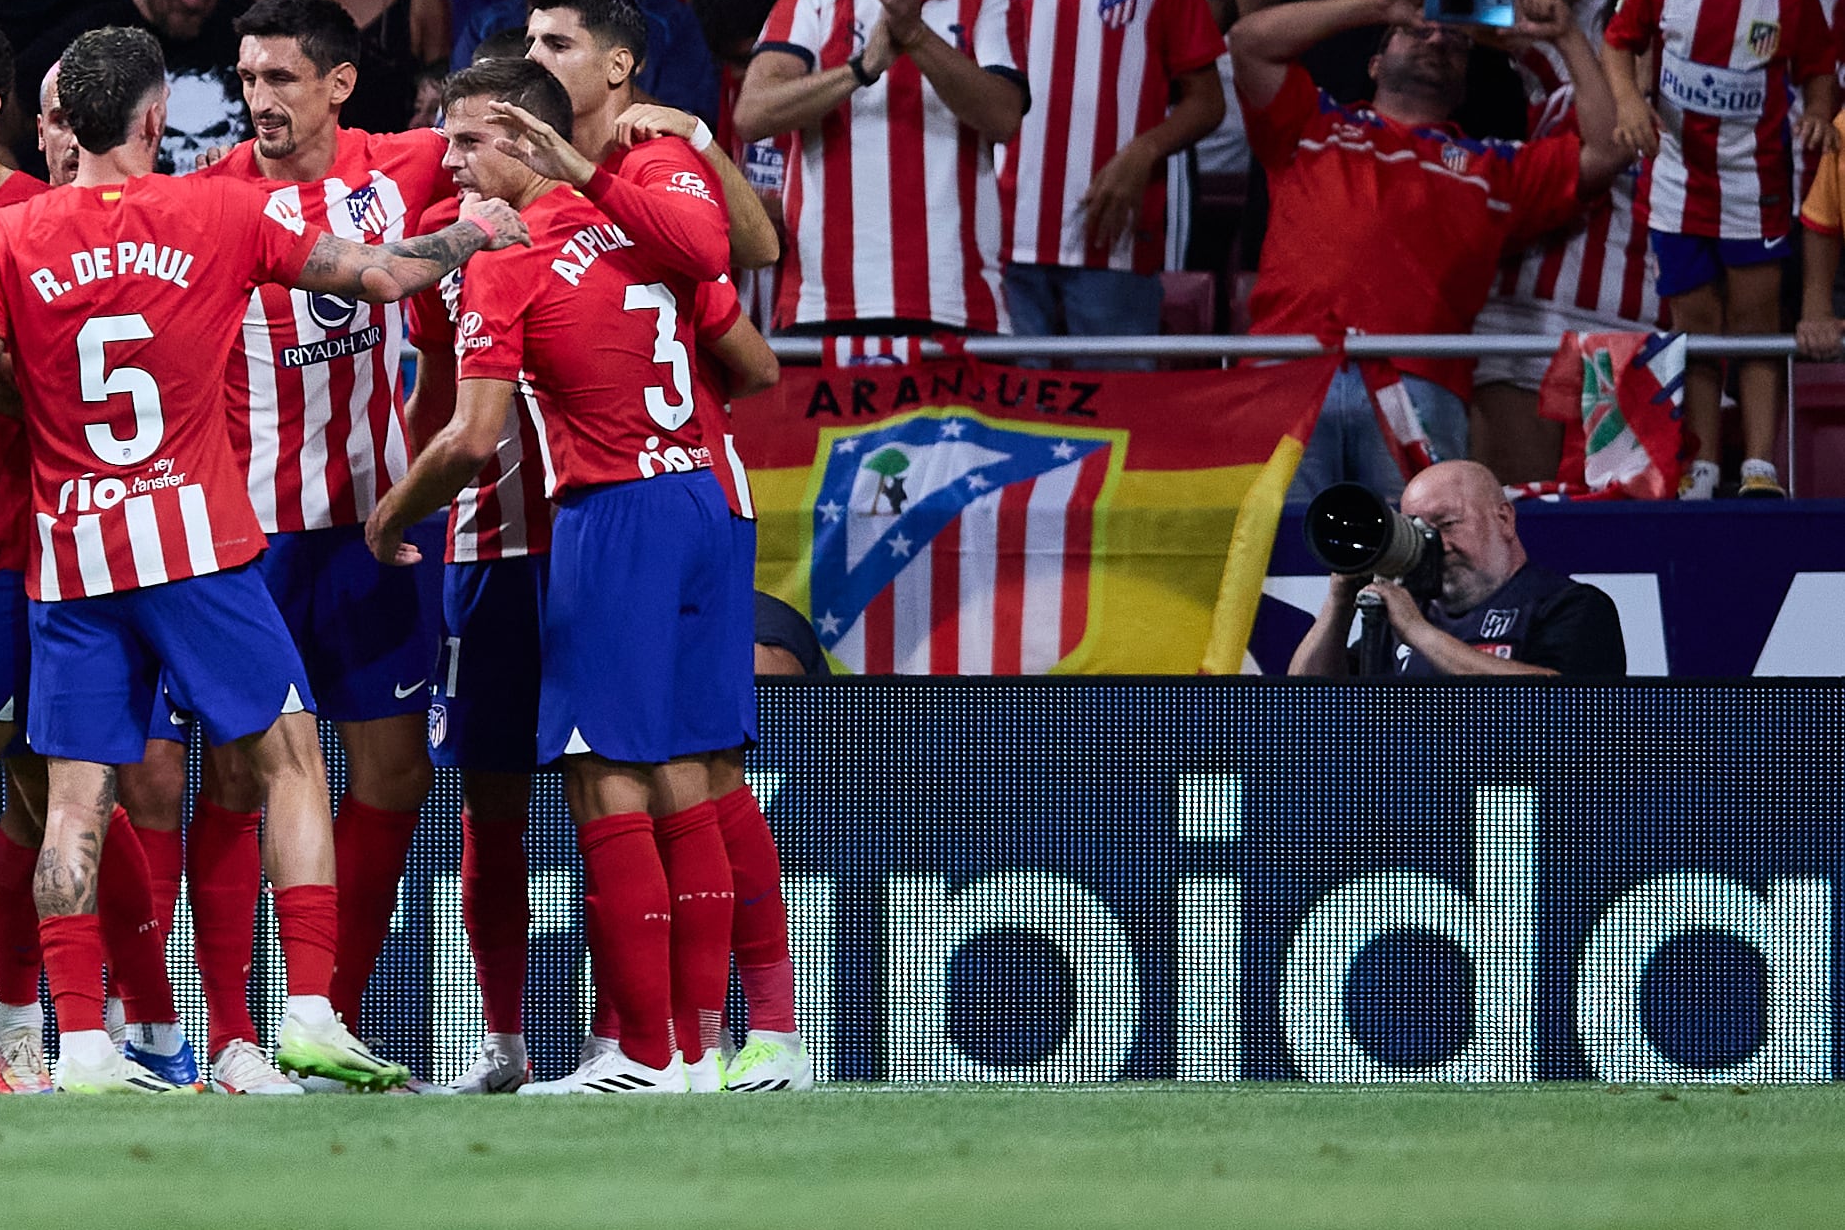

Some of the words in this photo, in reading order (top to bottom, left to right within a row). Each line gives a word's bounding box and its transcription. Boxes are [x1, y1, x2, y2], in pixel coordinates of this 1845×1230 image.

[1660, 73, 1762, 112] Plus500
[31, 266, 73, 304] R.
[71, 247, 113, 287] DE
[117, 240, 195, 289] PAUL
[284, 338, 355, 368] RIYADH
[354, 325, 381, 350] AIR
[624, 283, 695, 432] 3
[76, 314, 164, 467] 5
